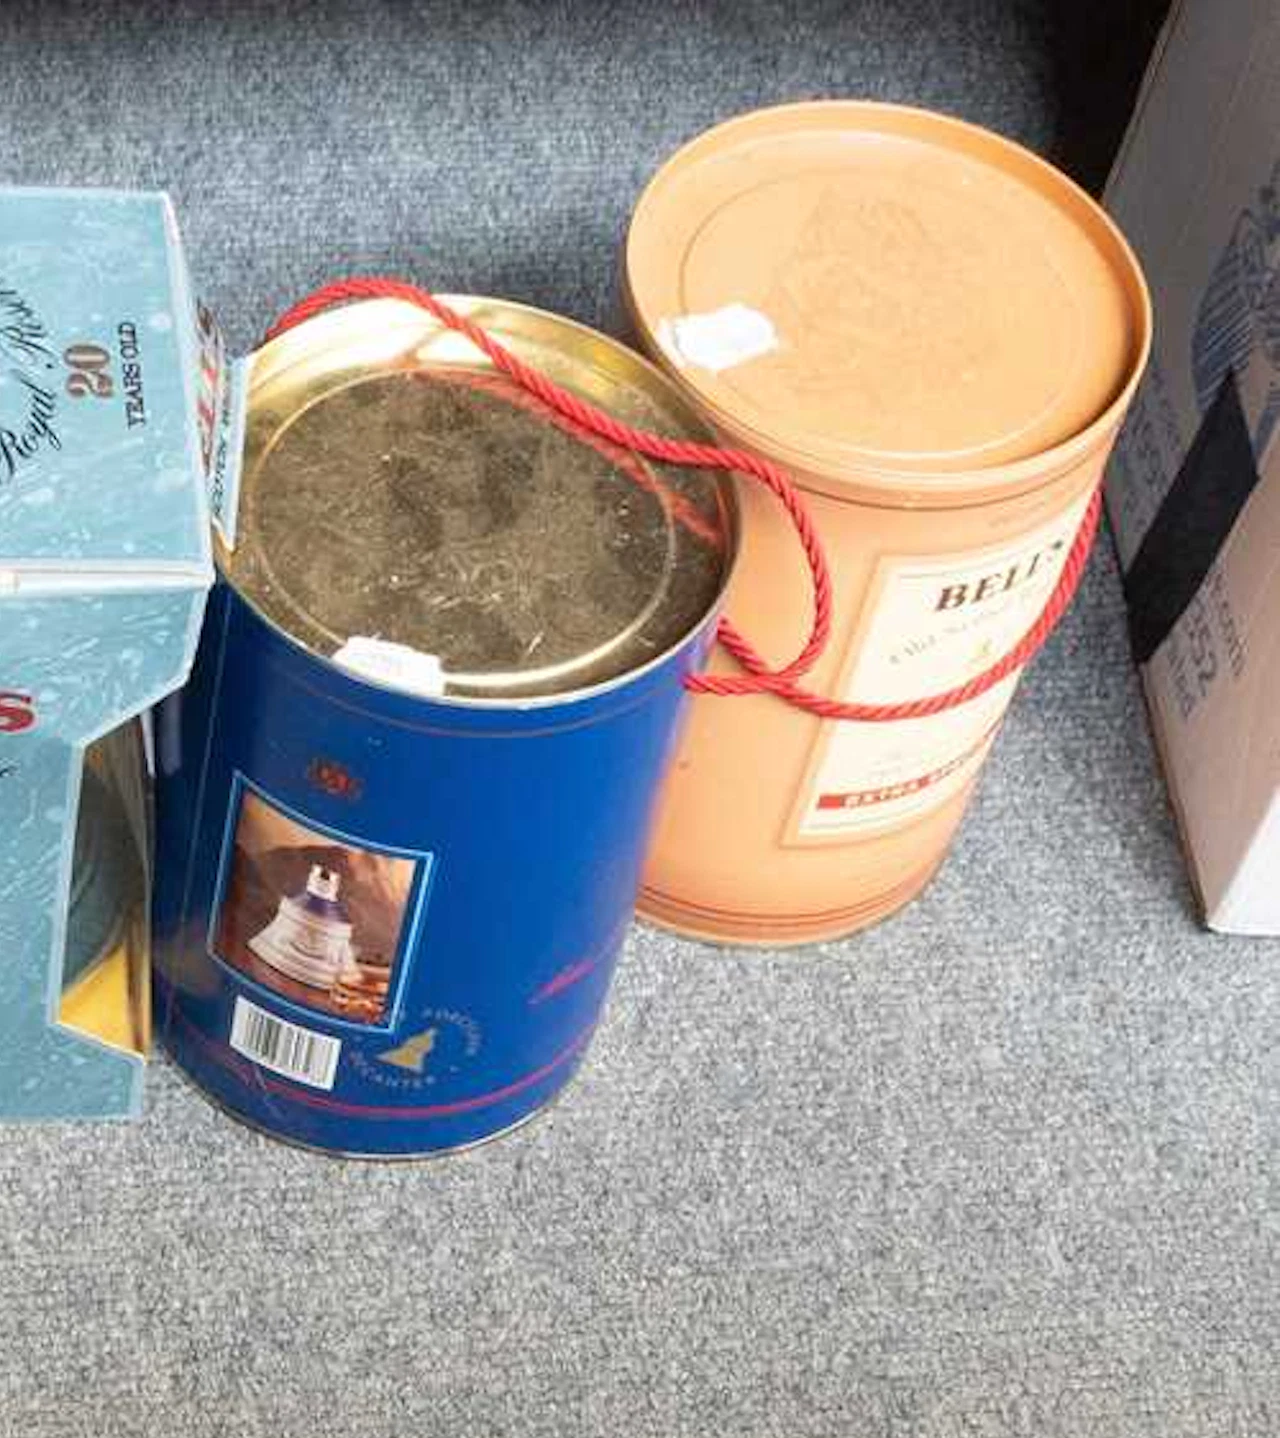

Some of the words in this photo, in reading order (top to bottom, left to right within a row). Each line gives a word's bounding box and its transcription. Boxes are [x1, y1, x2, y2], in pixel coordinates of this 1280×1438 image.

[117, 321, 139, 361] OLD
[63, 342, 114, 401] 20
[121, 362, 147, 430] YEARS
